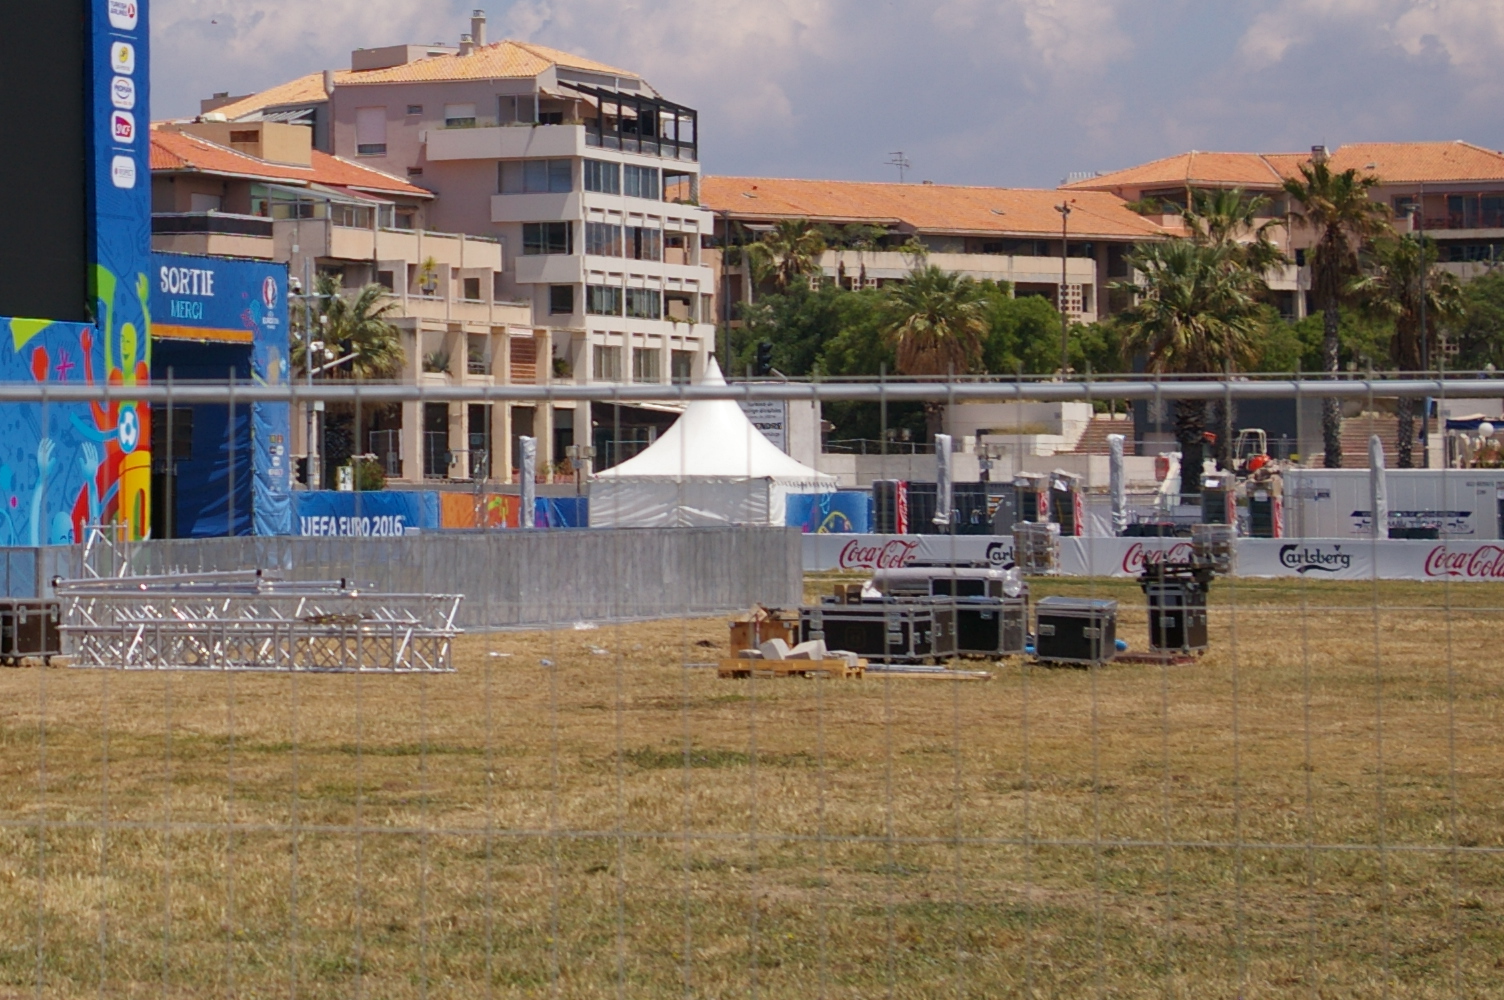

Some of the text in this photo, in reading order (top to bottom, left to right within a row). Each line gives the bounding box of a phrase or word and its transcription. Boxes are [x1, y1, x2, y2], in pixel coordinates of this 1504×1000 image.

[160, 265, 214, 297] SORTIE
[170, 299, 203, 320] MERCI
[300, 515, 403, 537] UEFA EURO 2016
[1278, 544, 1351, 574] Carlsberg
